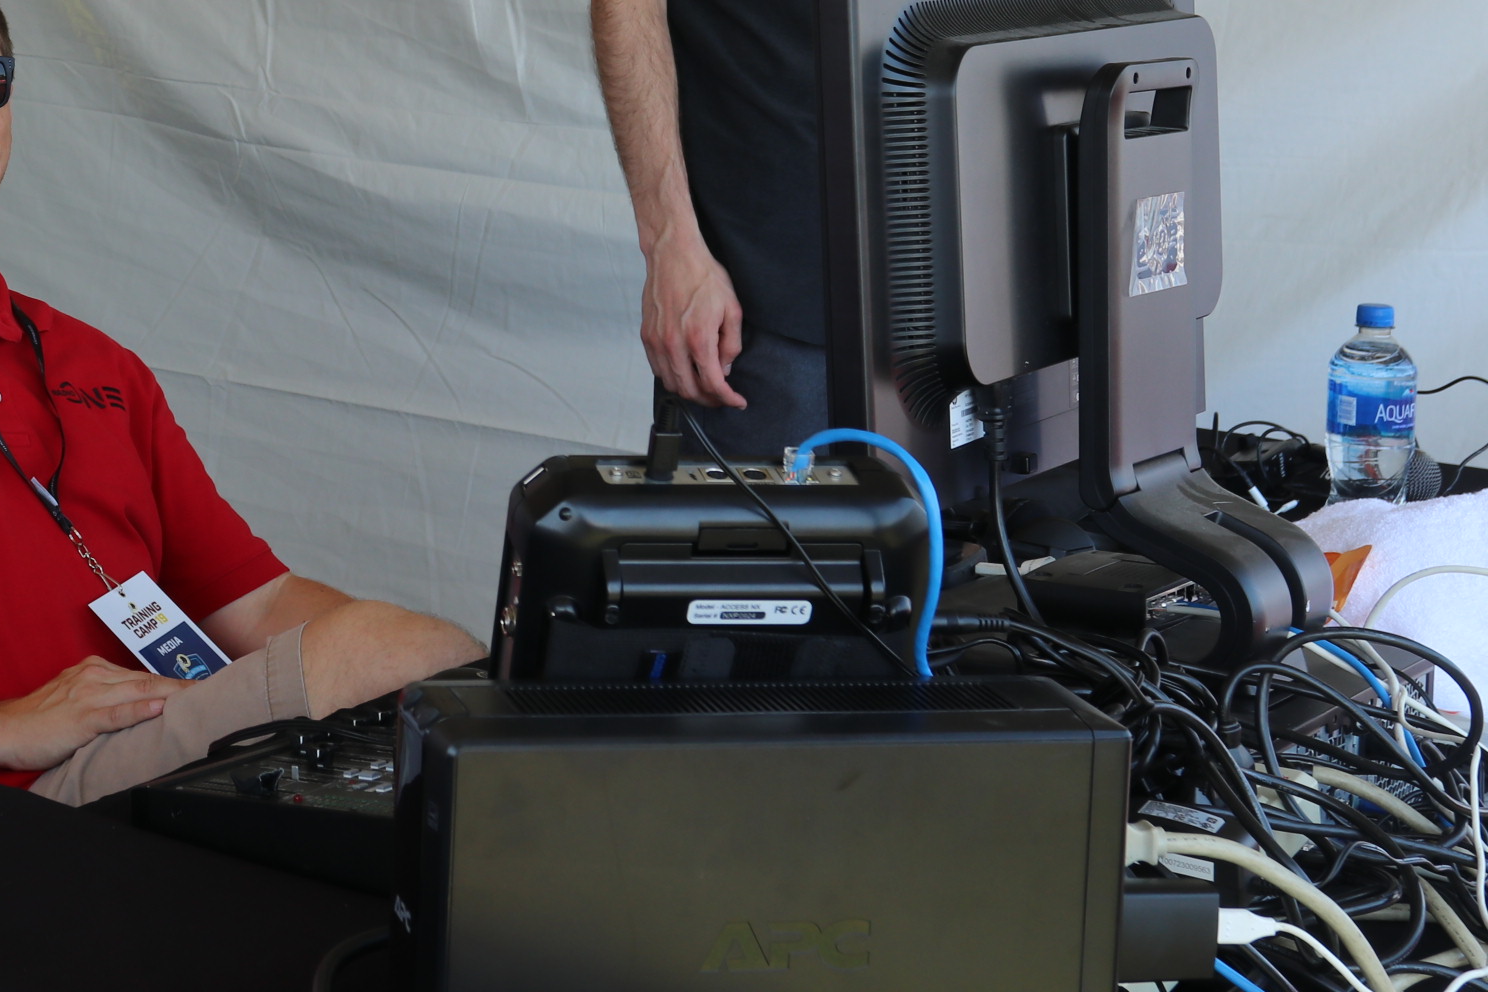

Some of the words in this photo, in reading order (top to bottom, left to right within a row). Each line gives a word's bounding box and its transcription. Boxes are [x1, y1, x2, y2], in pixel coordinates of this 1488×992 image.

[121, 601, 162, 630] TRAINING
[157, 636, 183, 656] MEDIA
[699, 919, 872, 974] APC
